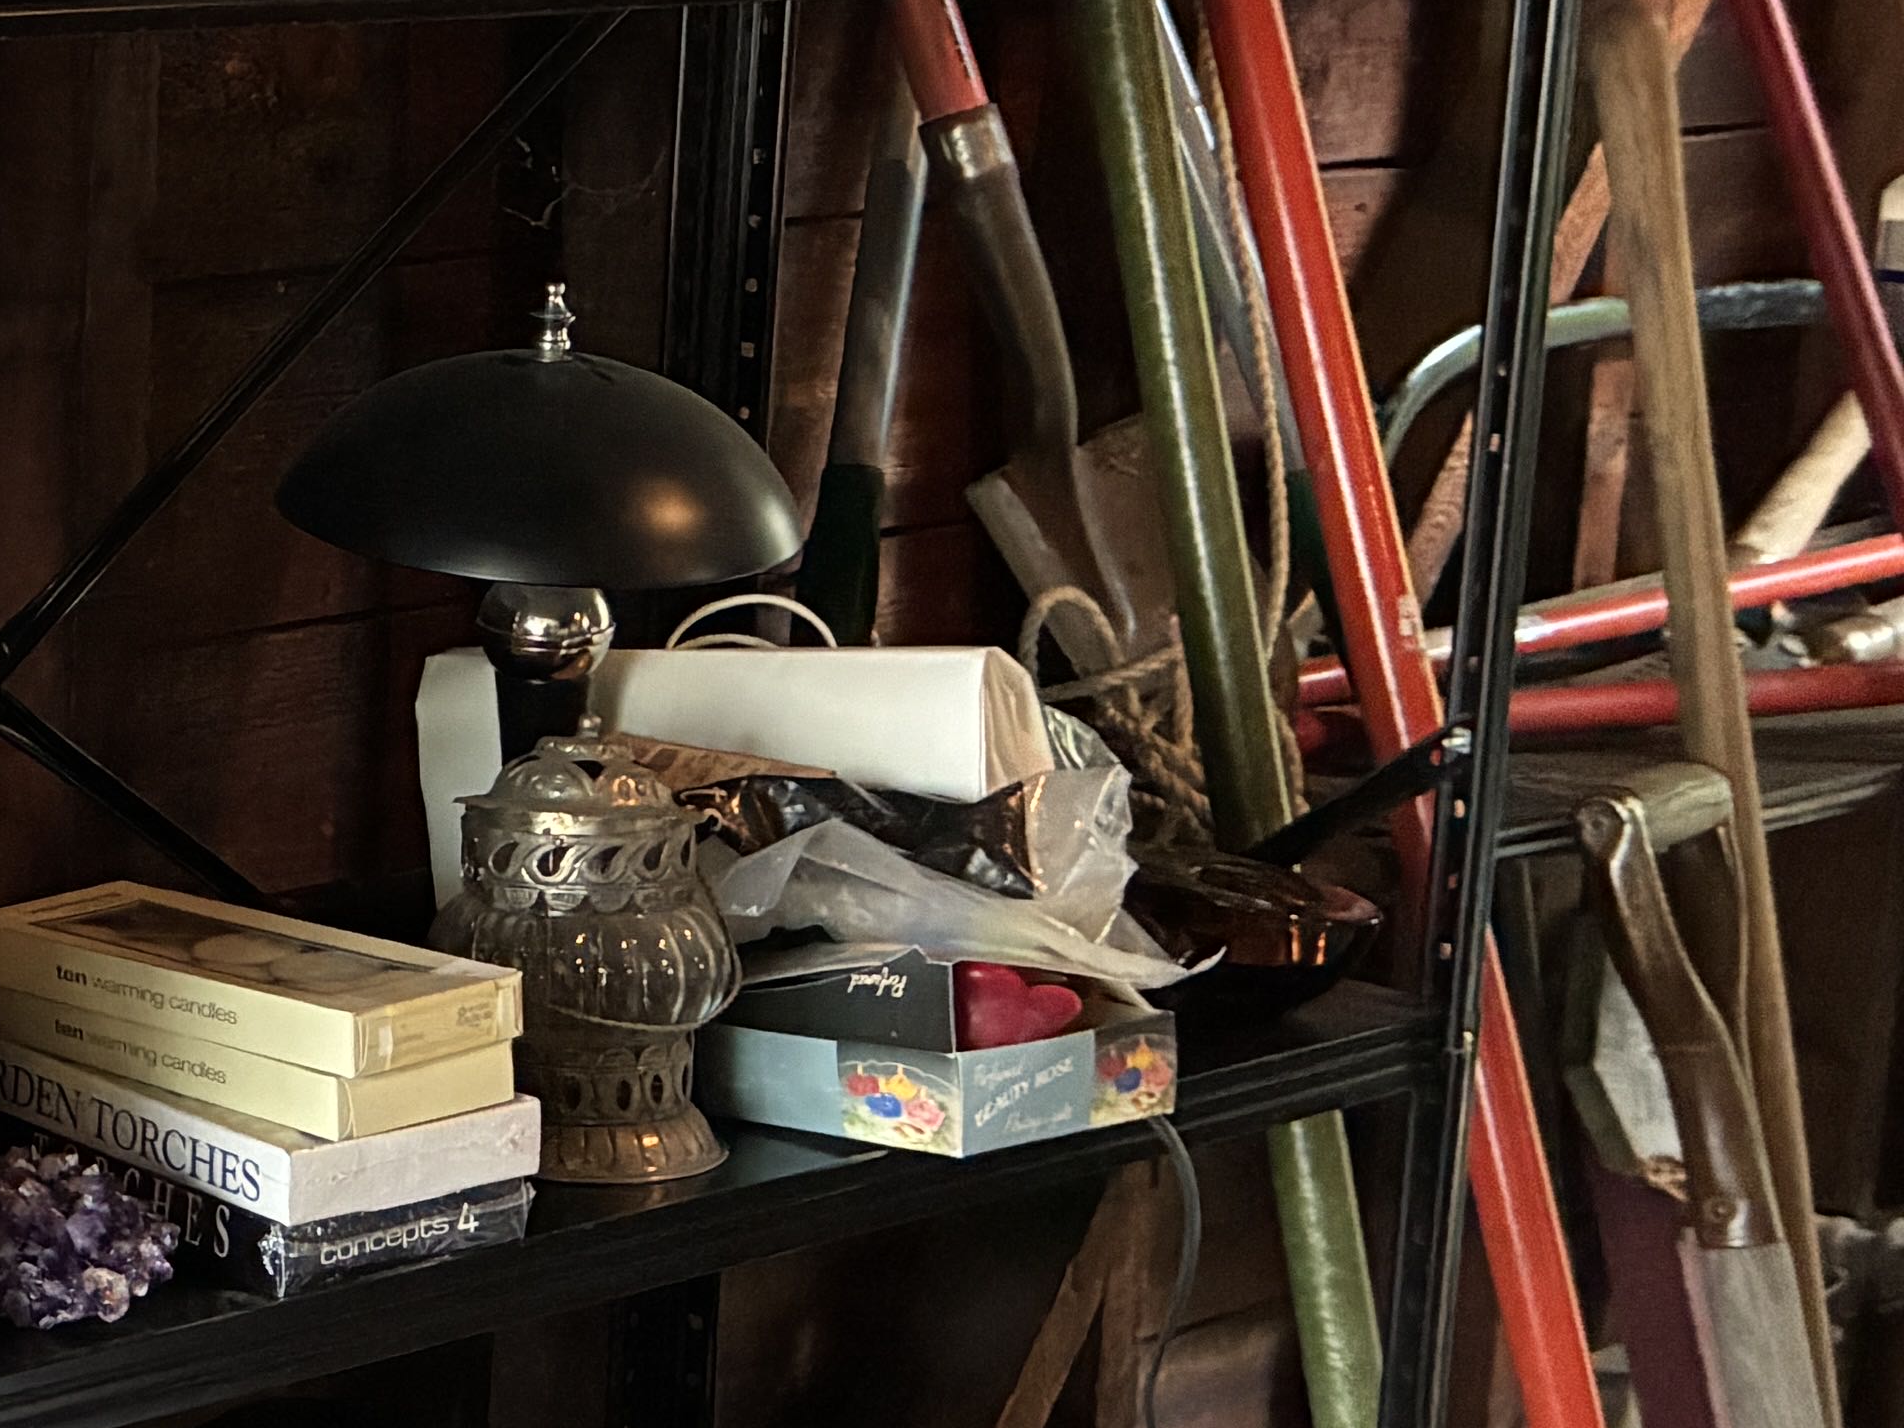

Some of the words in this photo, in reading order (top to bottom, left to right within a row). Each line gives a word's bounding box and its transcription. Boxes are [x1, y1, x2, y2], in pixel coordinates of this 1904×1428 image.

[56, 965, 87, 985] ten
[93, 975, 164, 1009] warming
[169, 994, 238, 1024] candles
[55, 1018, 84, 1040] ten
[161, 1053, 227, 1084] candles
[91, 1096, 261, 1202] TORCHES
[320, 1216, 450, 1265] concepts
[456, 1202, 480, 1234] 4
